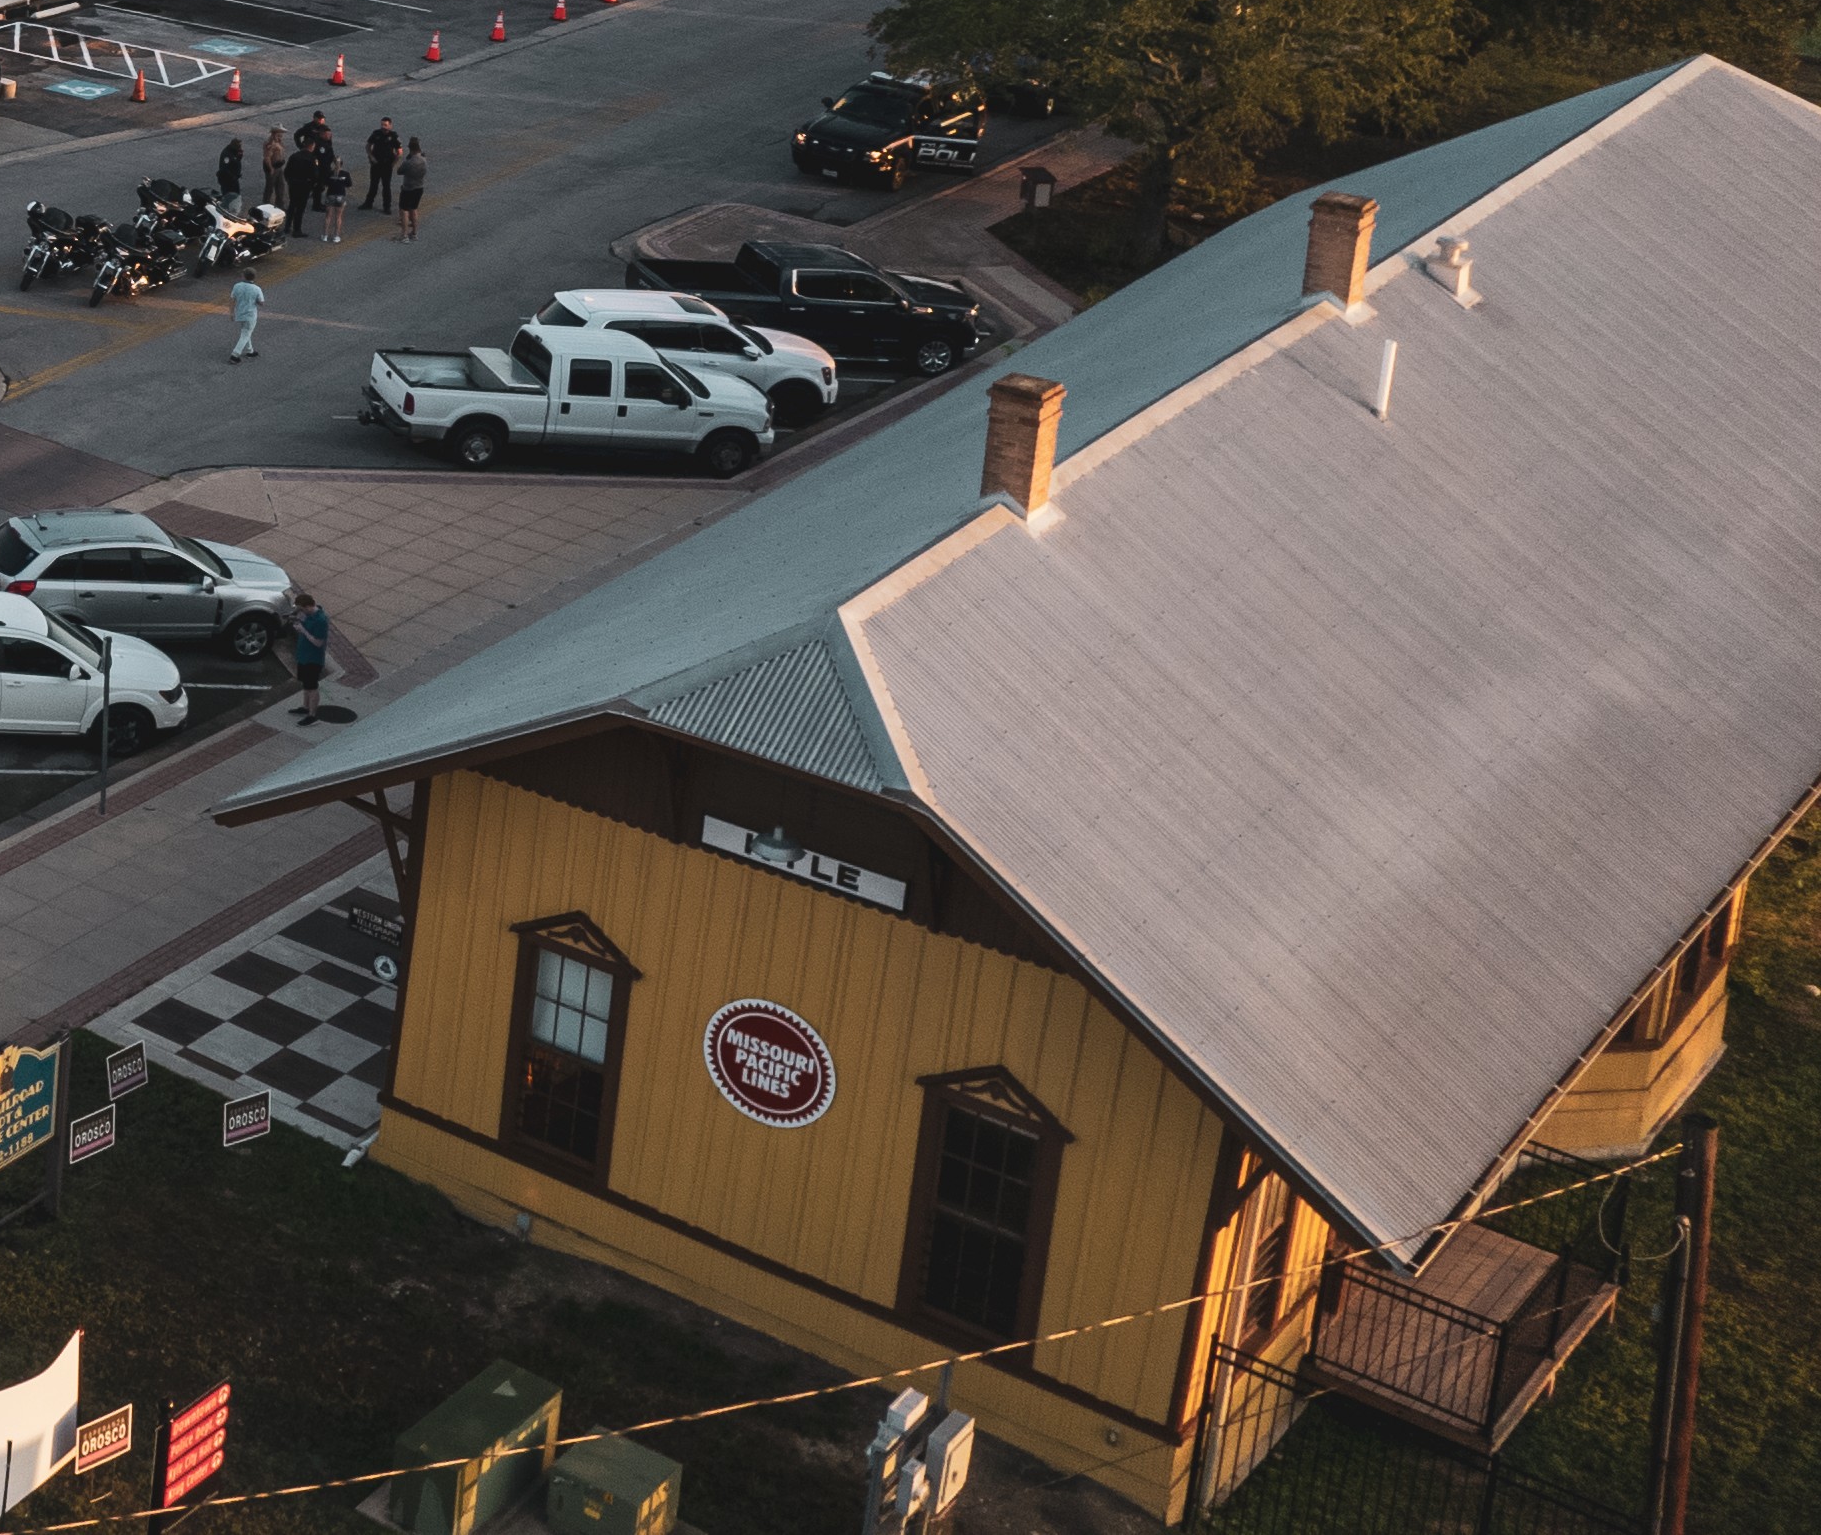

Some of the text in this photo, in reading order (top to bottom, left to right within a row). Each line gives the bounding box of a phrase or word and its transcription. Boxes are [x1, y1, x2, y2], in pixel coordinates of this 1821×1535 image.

[353, 908, 402, 933] WESTERN UNION
[357, 917, 397, 938] TELEGRAPH
[726, 1028, 815, 1075] MISSOURI
[112, 1058, 143, 1083] OROSCO
[735, 1049, 802, 1086] PACIFIC
[741, 1068, 791, 1099] LINES
[6, 1105, 50, 1138] CENTER
[13, 1106, 23, 1119] &
[229, 1107, 266, 1130] OROSCO
[74, 1121, 111, 1148] OROSCO
[83, 1417, 125, 1439] ESPERANZA
[173, 1397, 218, 1437] Downtown
[81, 1423, 127, 1456] OROSCO
[170, 1434, 194, 1458] Police
[168, 1441, 213, 1482] Kyle City Hall
[186, 1465, 208, 1487] Center
